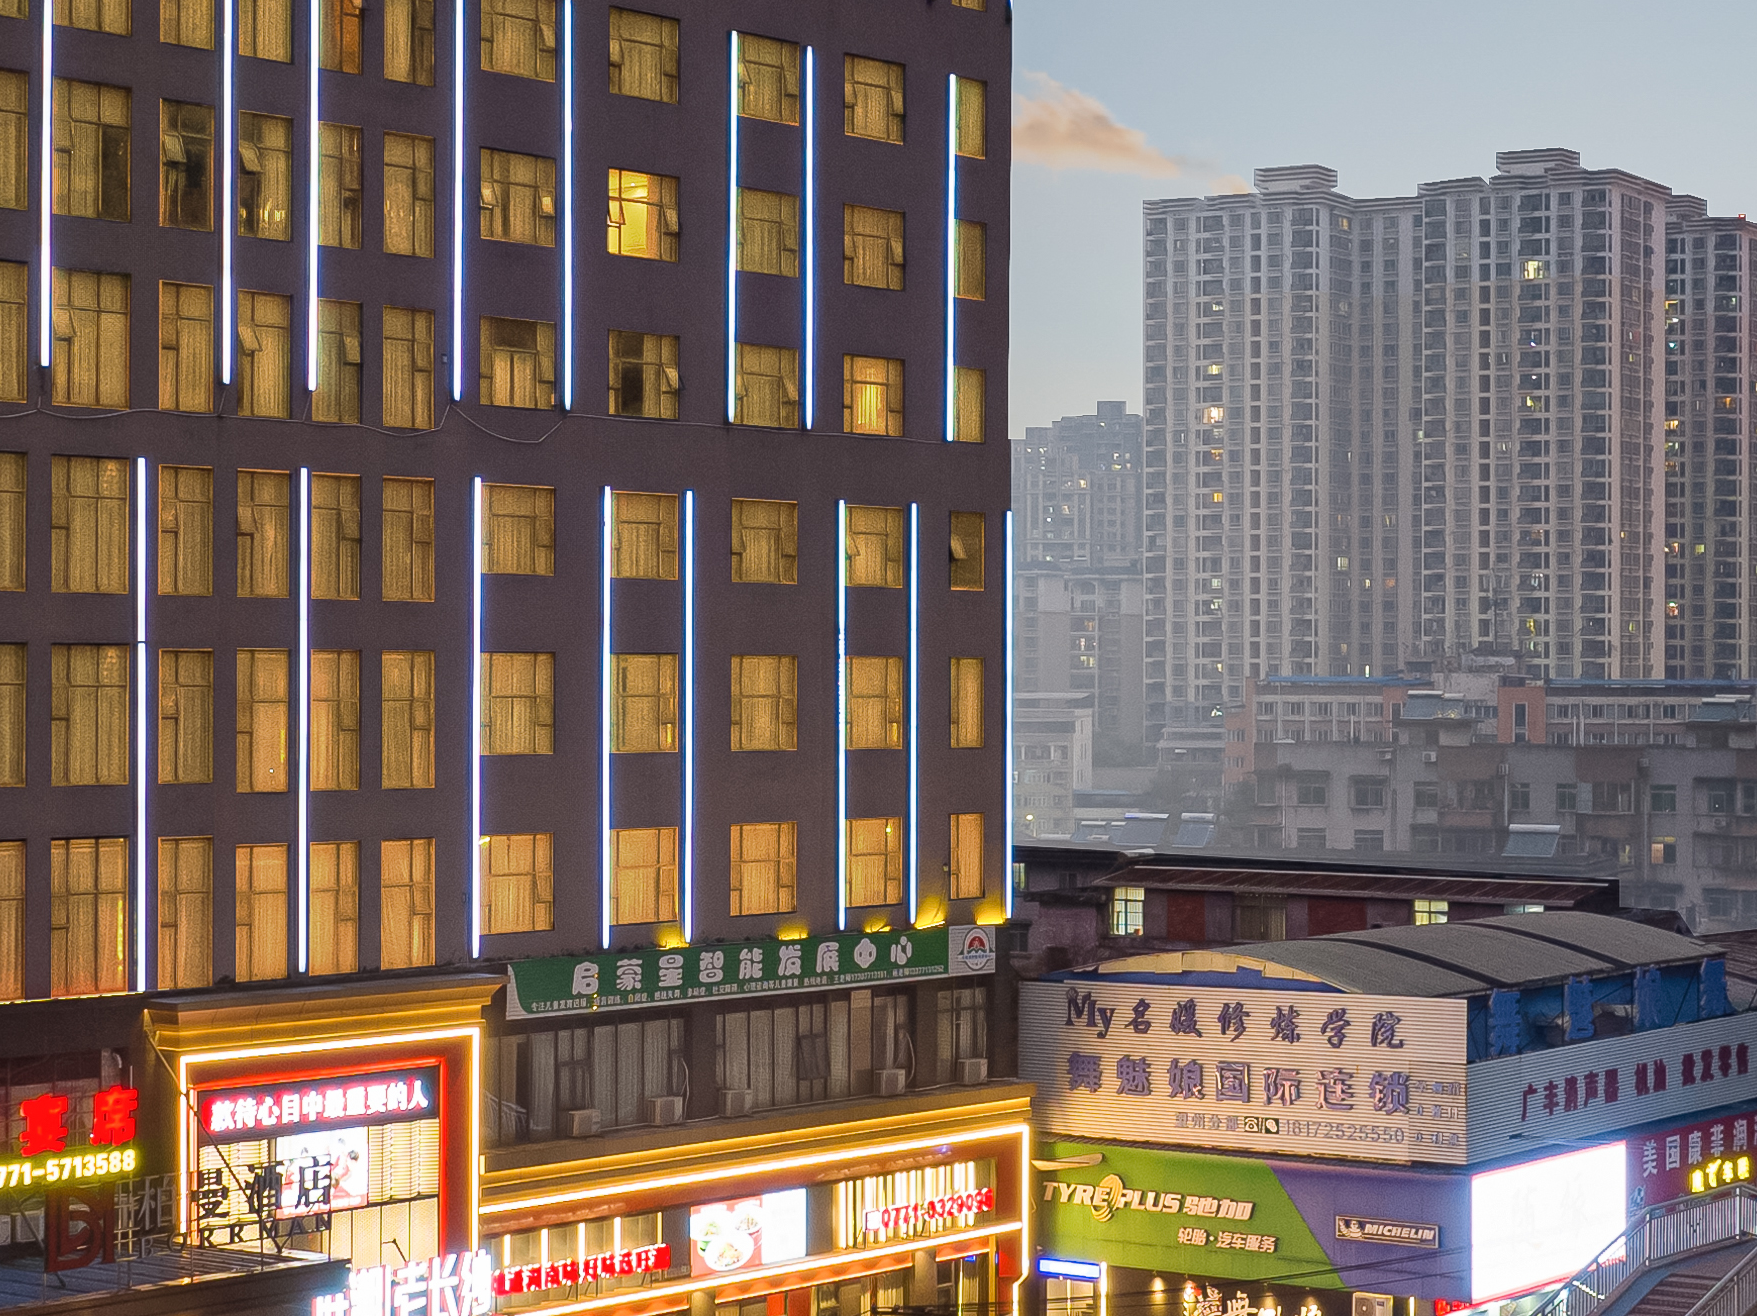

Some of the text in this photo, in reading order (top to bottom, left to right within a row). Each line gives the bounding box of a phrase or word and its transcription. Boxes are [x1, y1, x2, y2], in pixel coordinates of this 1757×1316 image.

[572, 936, 913, 995] 启蒙星智能发展中心
[1066, 1051, 1410, 1114] 舞魅娘国际连锁
[1183, 1195, 1255, 1222] 驰加
[140, 1214, 332, 1259] BORRMAN
[1363, 1222, 1436, 1241] MICHELIN
